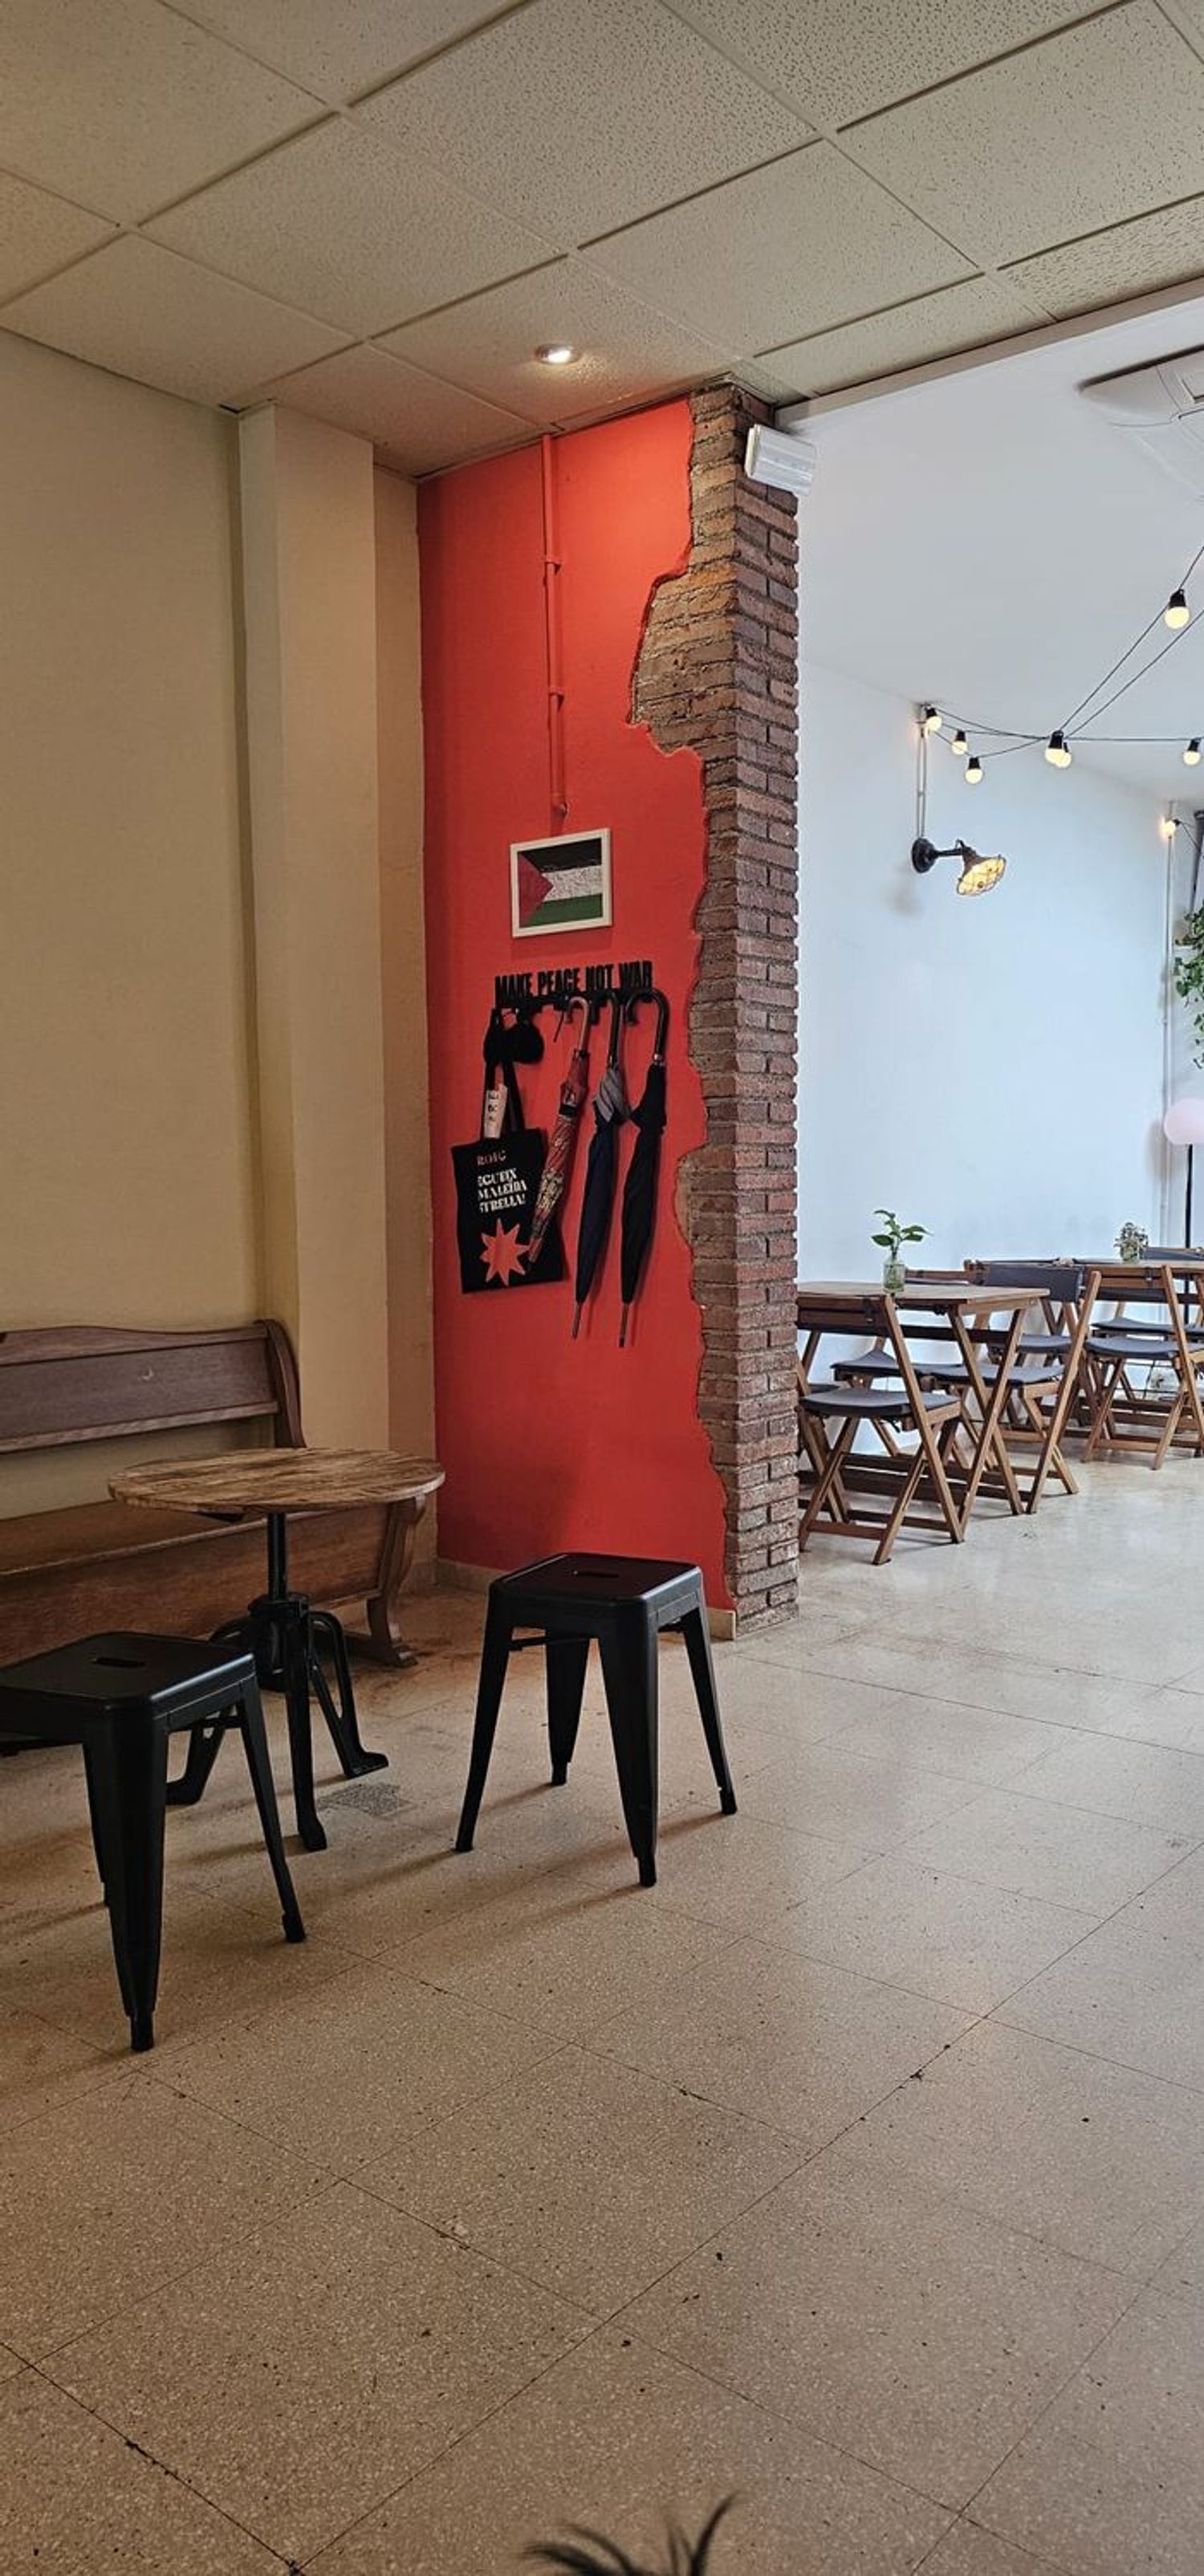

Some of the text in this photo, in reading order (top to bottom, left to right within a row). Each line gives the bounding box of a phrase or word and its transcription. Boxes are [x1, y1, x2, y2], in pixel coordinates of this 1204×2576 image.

[495, 961, 653, 1000] MAKE PEACE NOT WAR
